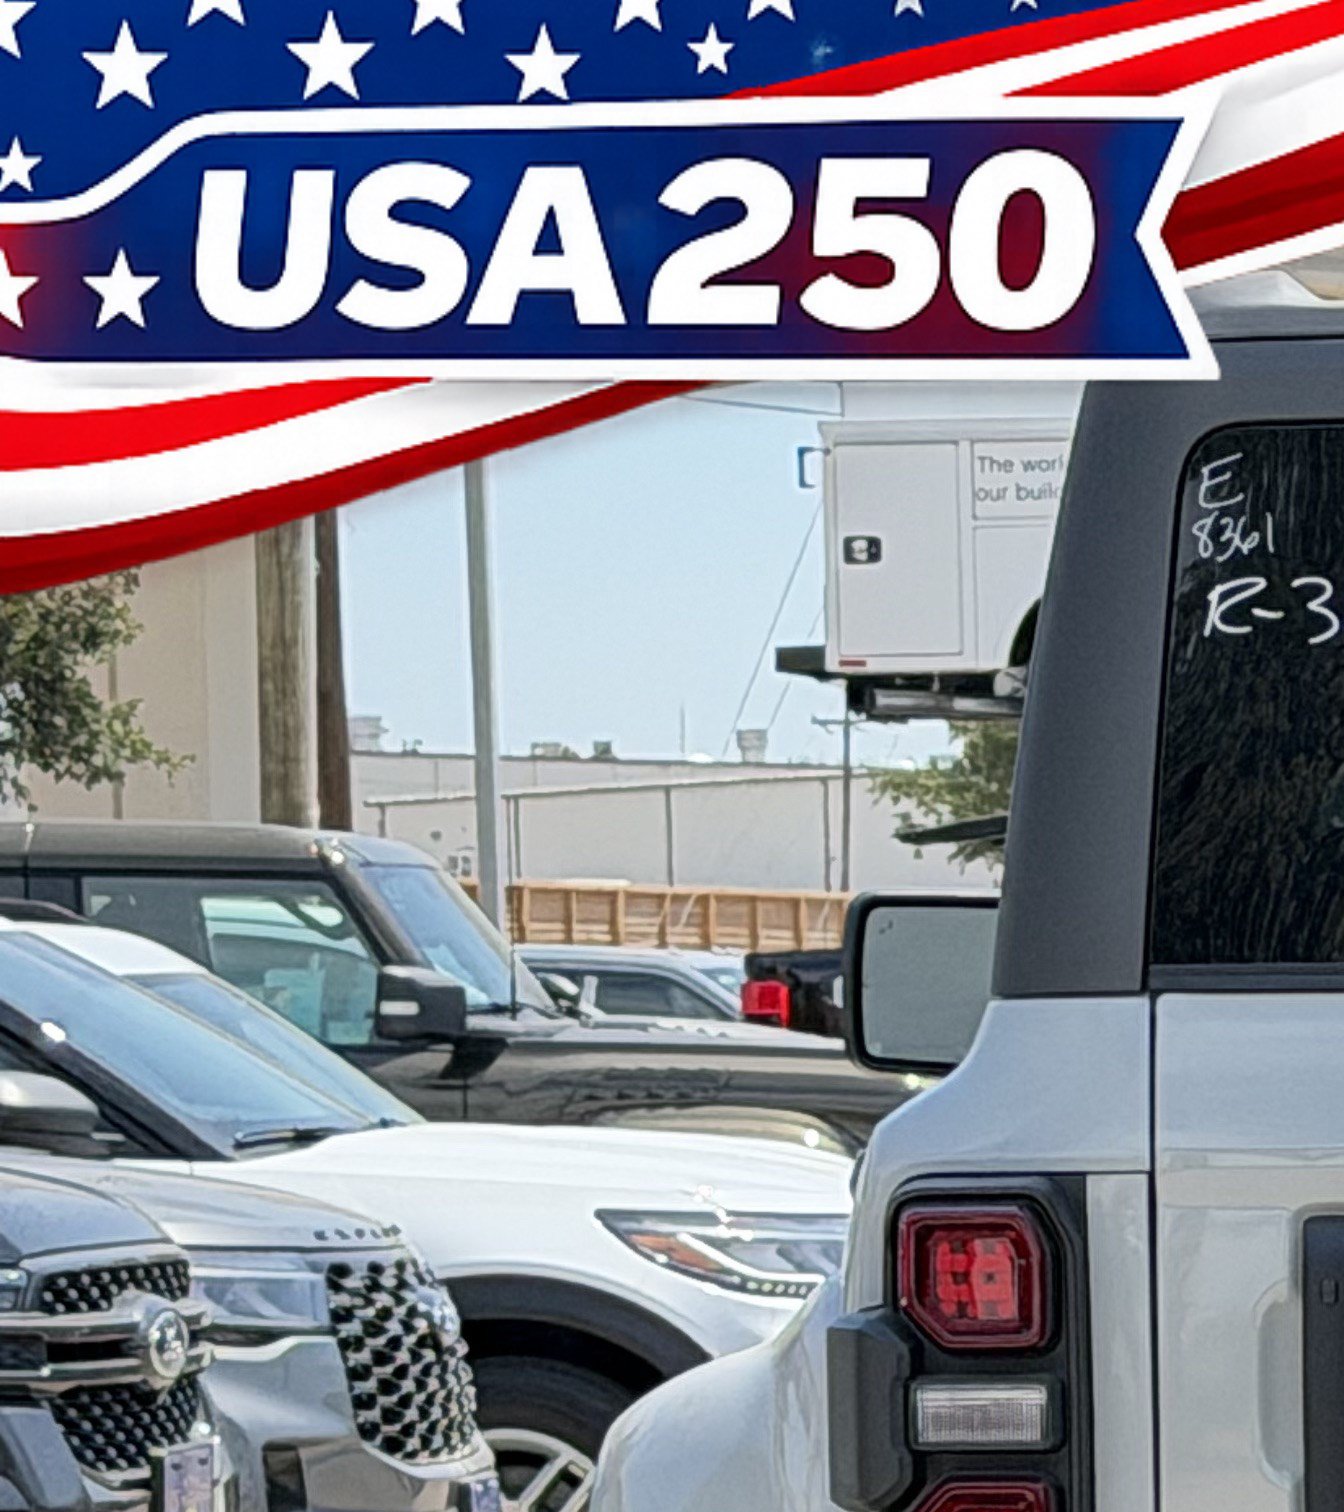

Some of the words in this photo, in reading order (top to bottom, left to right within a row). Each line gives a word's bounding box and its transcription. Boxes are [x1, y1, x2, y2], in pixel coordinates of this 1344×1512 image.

[977, 455, 1015, 473] The
[1199, 452, 1244, 509] E
[976, 486, 1009, 502] our
[1191, 512, 1275, 562] 8361
